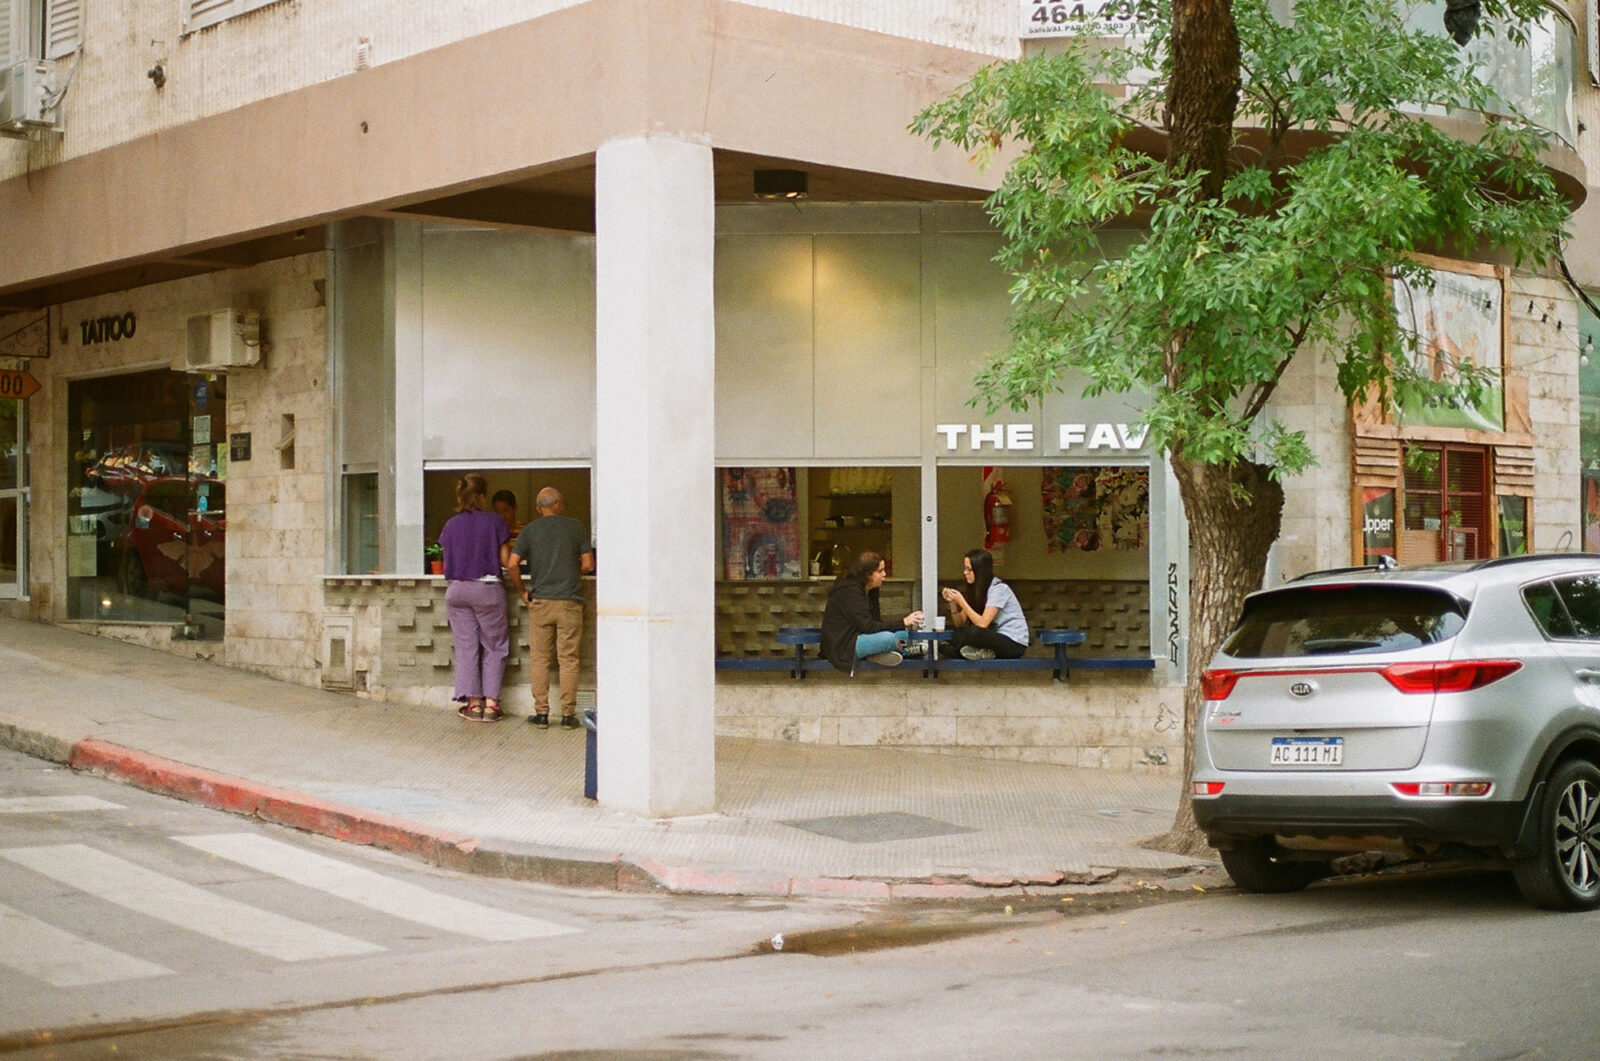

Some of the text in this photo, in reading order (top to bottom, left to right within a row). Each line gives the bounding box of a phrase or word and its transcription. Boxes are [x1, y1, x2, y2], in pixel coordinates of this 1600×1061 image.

[80, 311, 136, 345] TATTOO
[937, 423, 1150, 450] THE FAV
[1293, 684, 1309, 694] KIA
[1273, 746, 1338, 762] AC 111 MI
